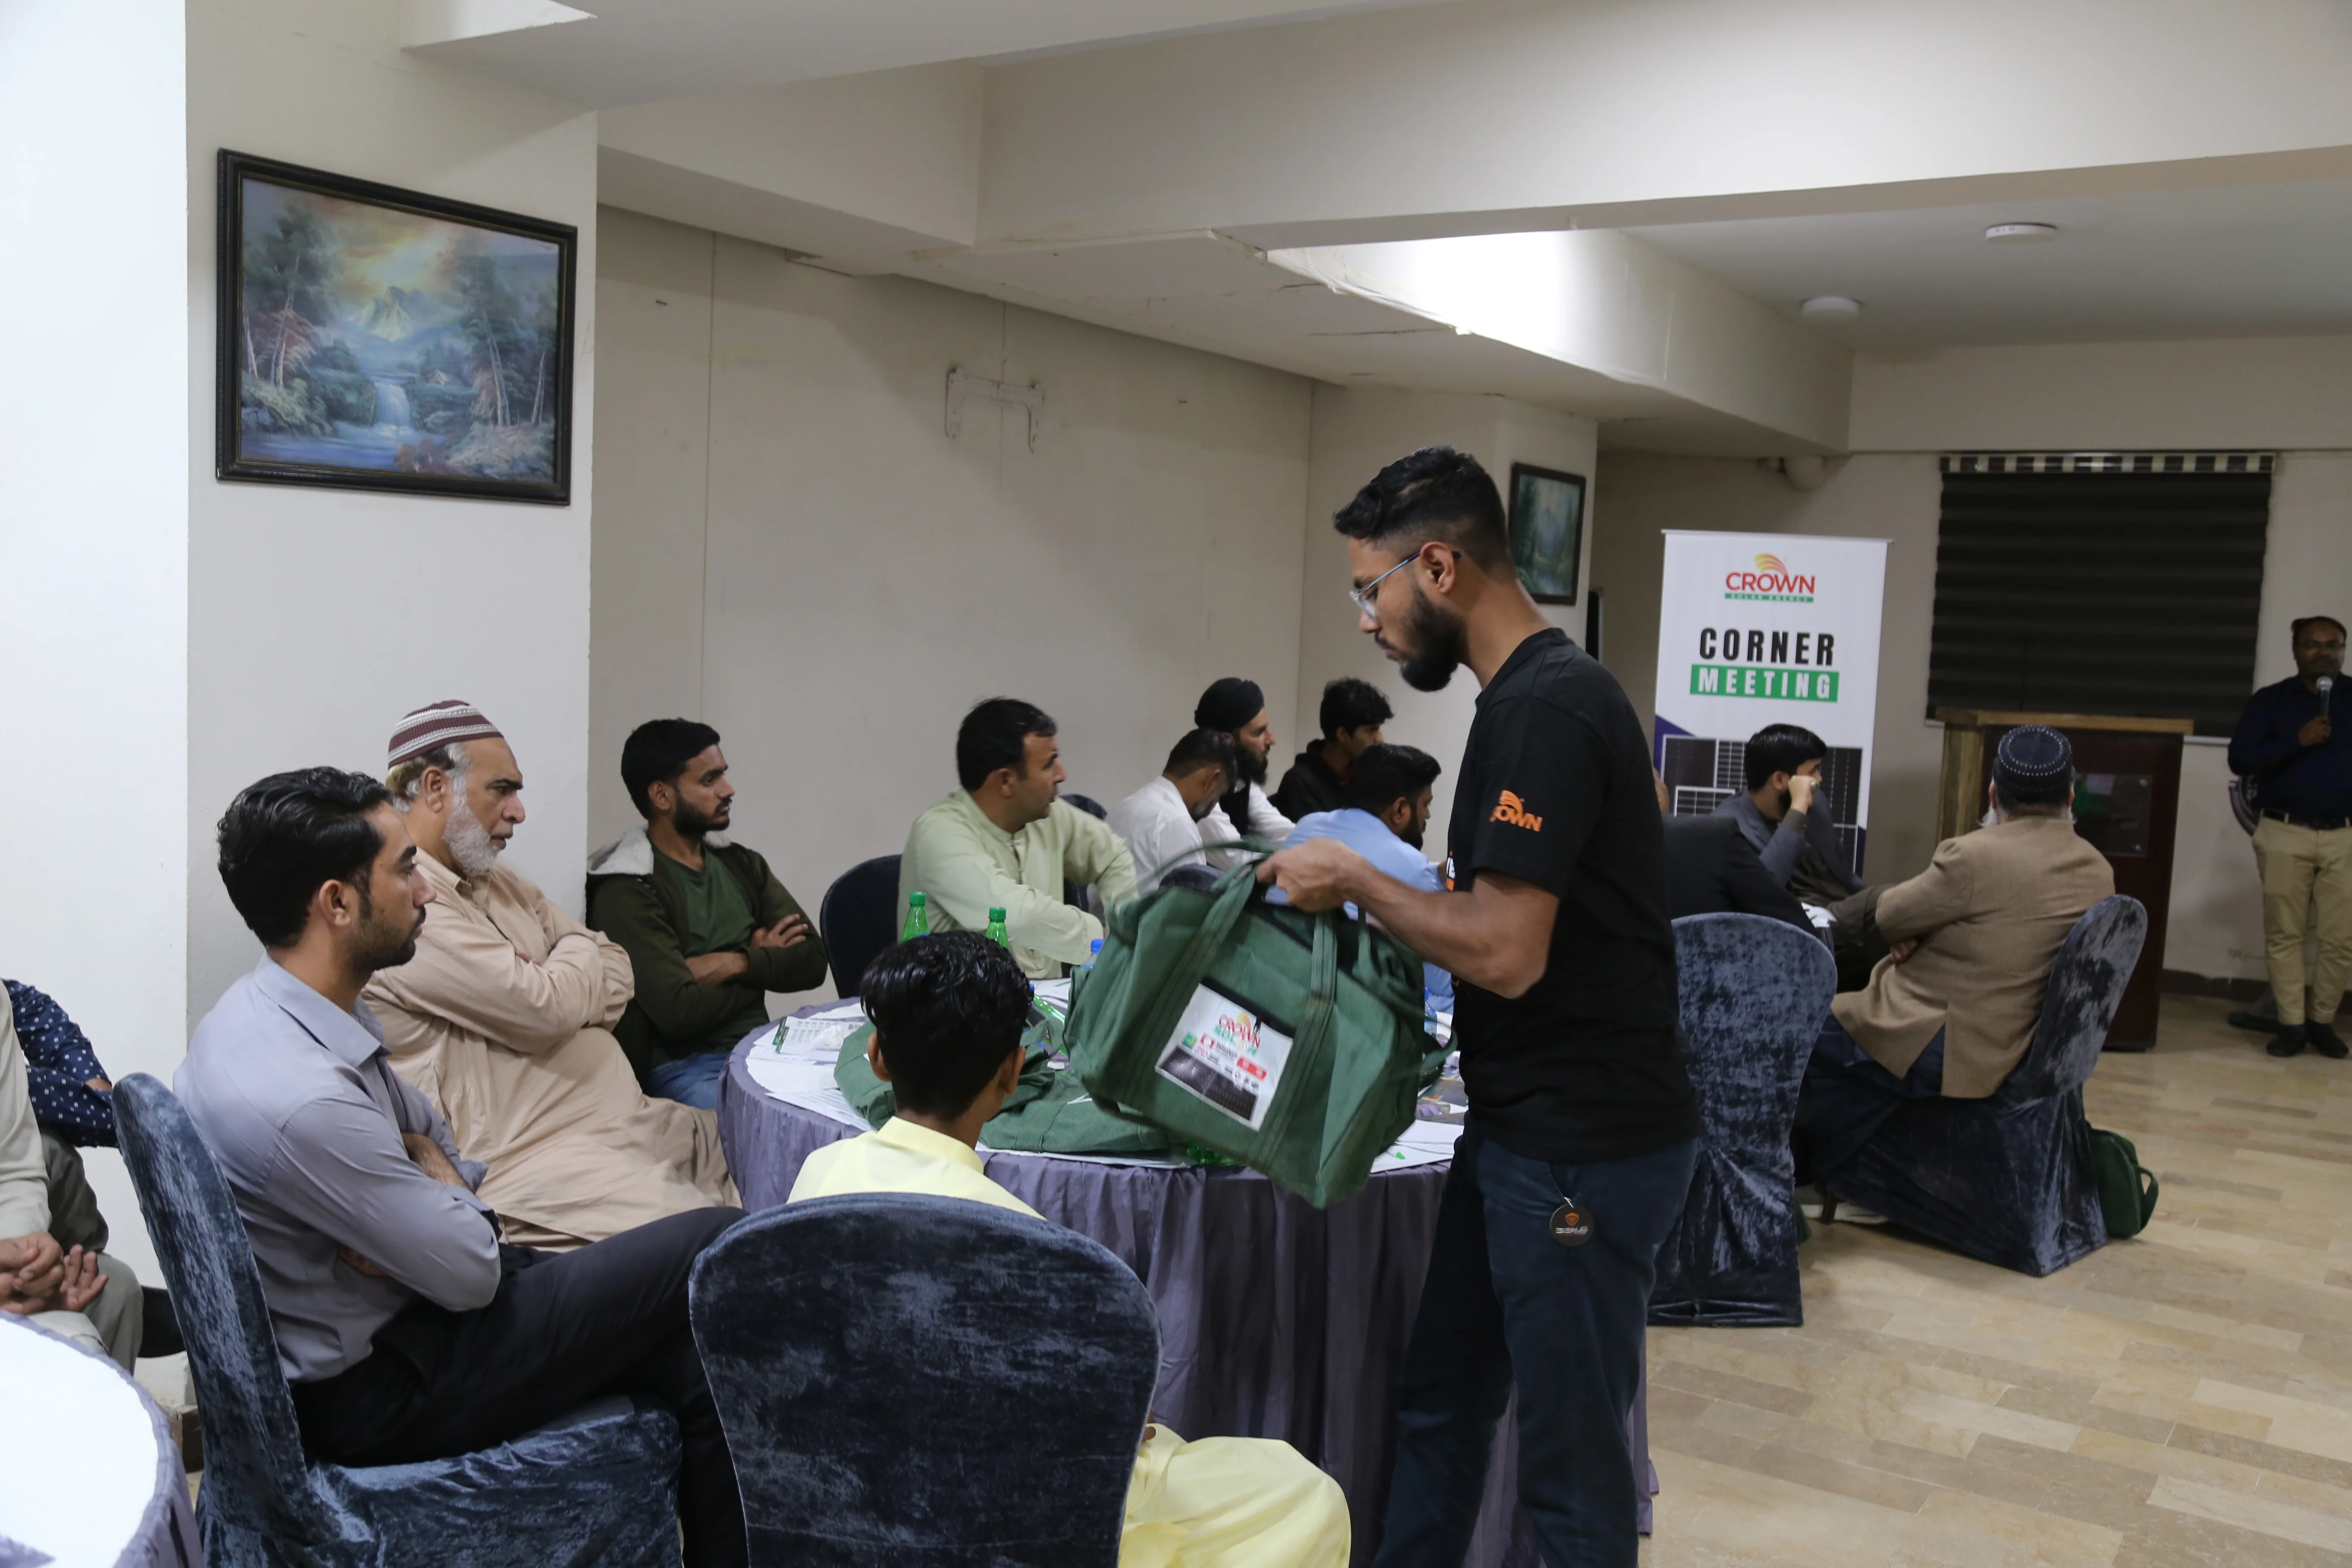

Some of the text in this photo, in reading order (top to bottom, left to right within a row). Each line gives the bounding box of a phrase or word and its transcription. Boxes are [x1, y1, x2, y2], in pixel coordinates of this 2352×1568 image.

[1726, 572, 1816, 594] CROWN
[1699, 628, 1835, 666] CORNER
[1698, 667, 1831, 699] MEETING
